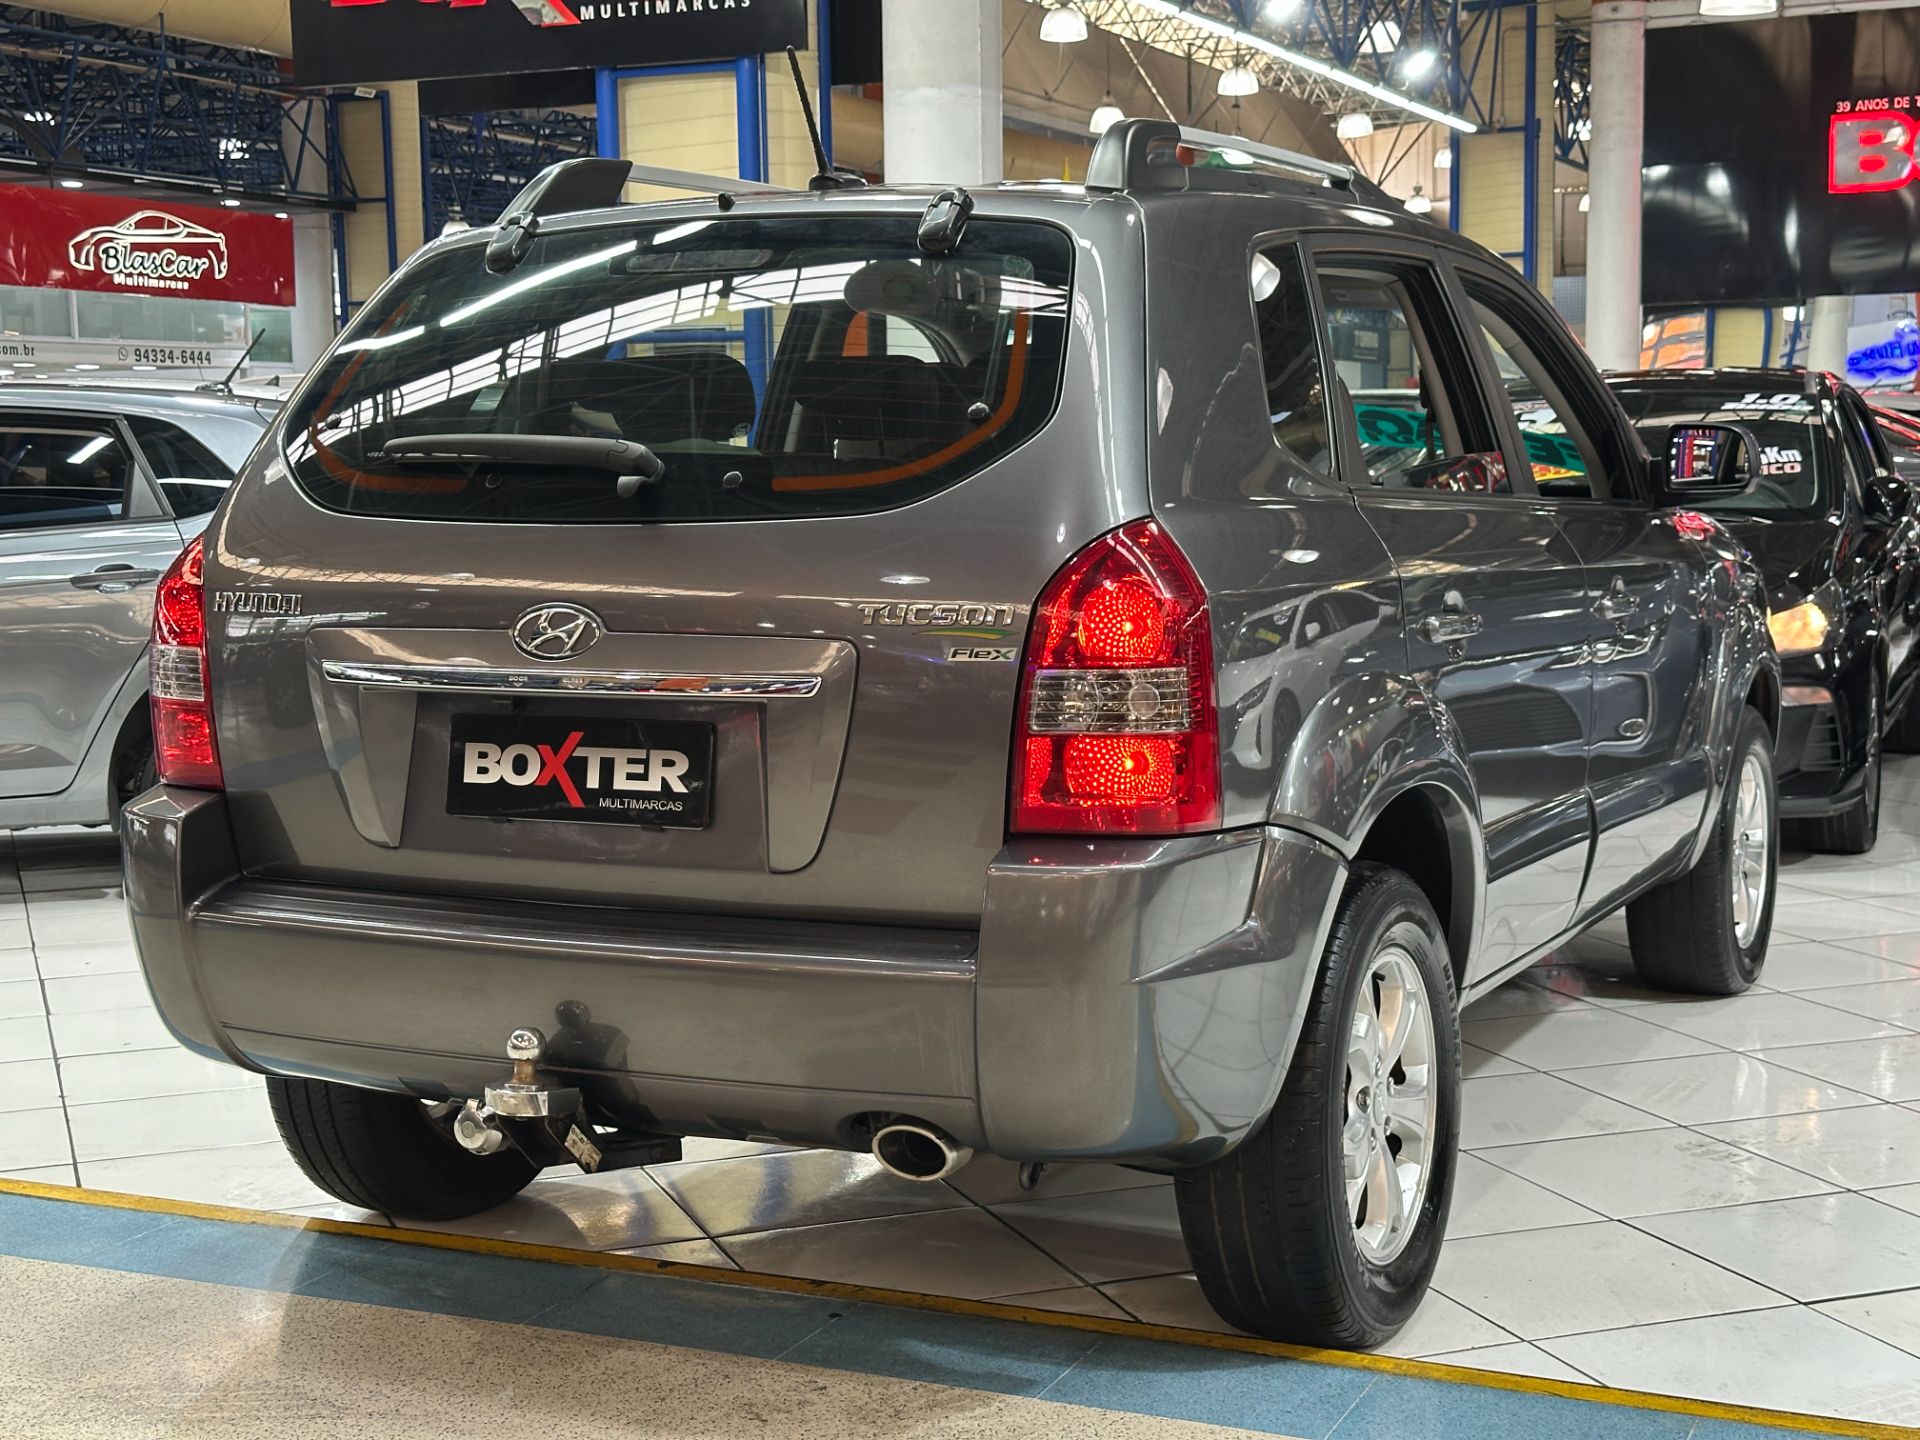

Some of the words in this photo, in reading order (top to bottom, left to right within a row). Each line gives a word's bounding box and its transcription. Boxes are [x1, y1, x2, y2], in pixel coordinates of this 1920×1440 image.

[1836, 101, 1851, 113] 39
[1855, 98, 1889, 112] ANOS
[1894, 96, 1910, 109] DE
[1828, 110, 1920, 194] B
[100, 242, 209, 280] BlasCar
[113, 273, 190, 290] Multimarcas
[0, 343, 35, 356] om.br
[134, 348, 212, 365] 94334-6444
[213, 591, 303, 614] HYUNDAI
[857, 603, 1015, 626] TUCSON
[463, 731, 689, 808] BOXTER
[599, 797, 683, 811] MULTIMARCAS
